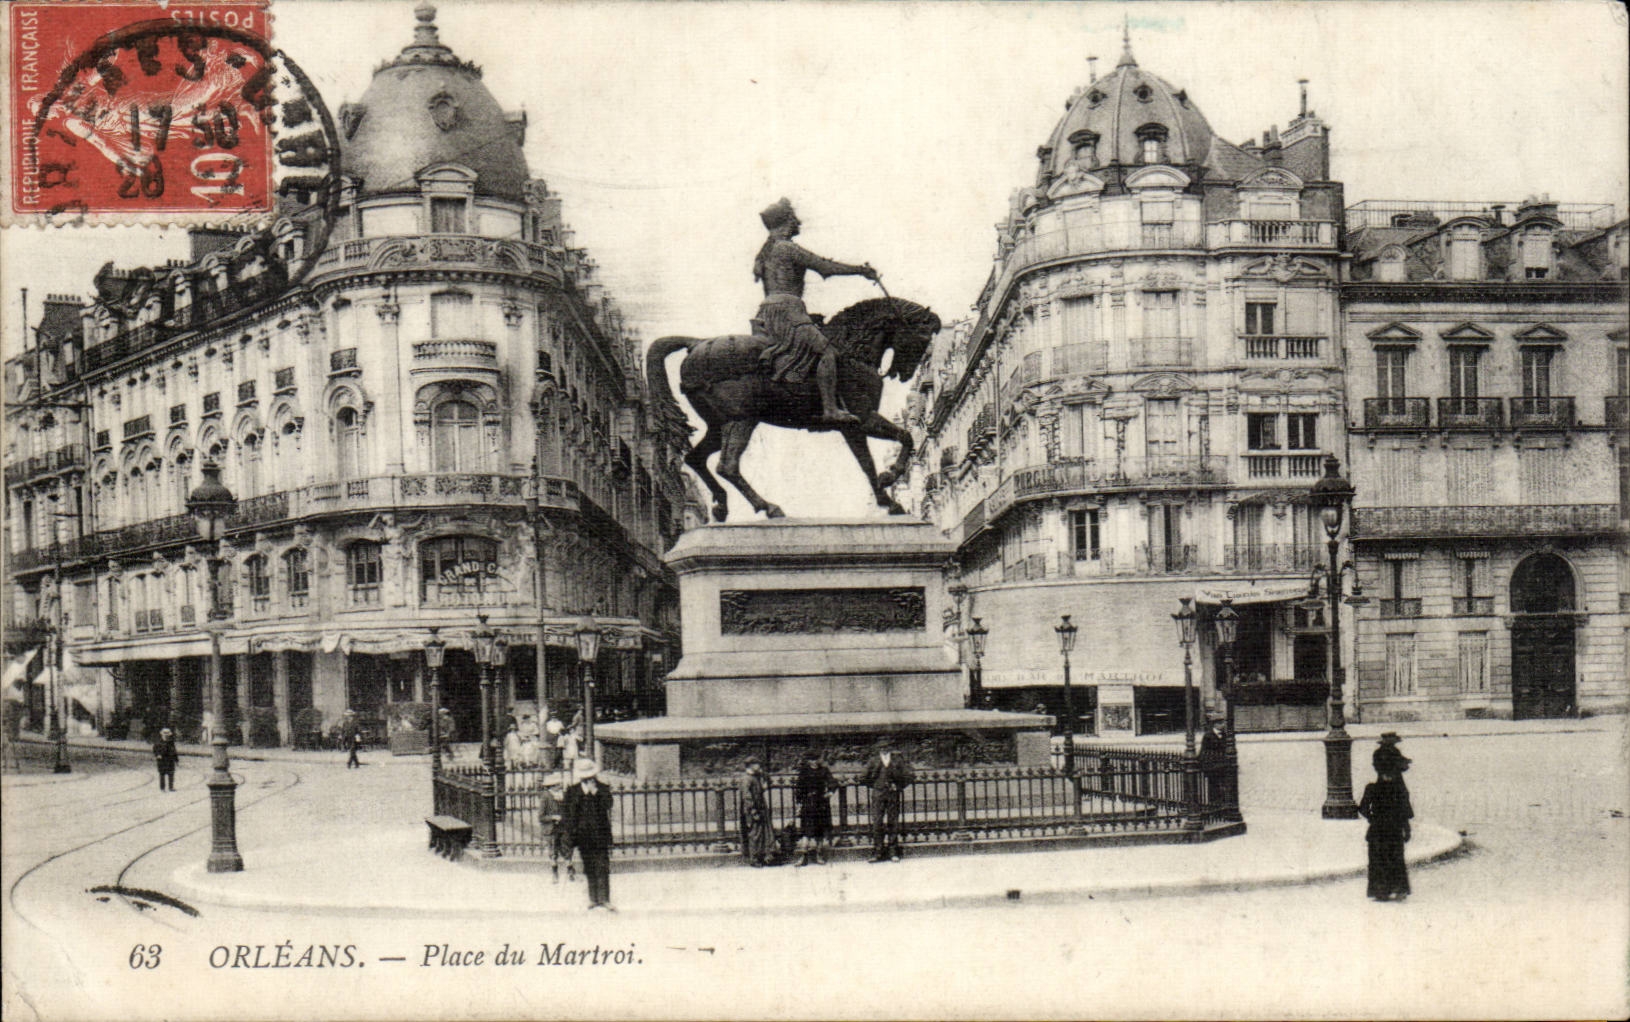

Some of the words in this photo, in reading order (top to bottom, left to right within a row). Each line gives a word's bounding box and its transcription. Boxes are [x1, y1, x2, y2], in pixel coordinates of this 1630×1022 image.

[171, 10, 254, 29] POSTES
[21, 10, 41, 91] FRANÇAISE
[438, 561, 480, 586] GRAND
